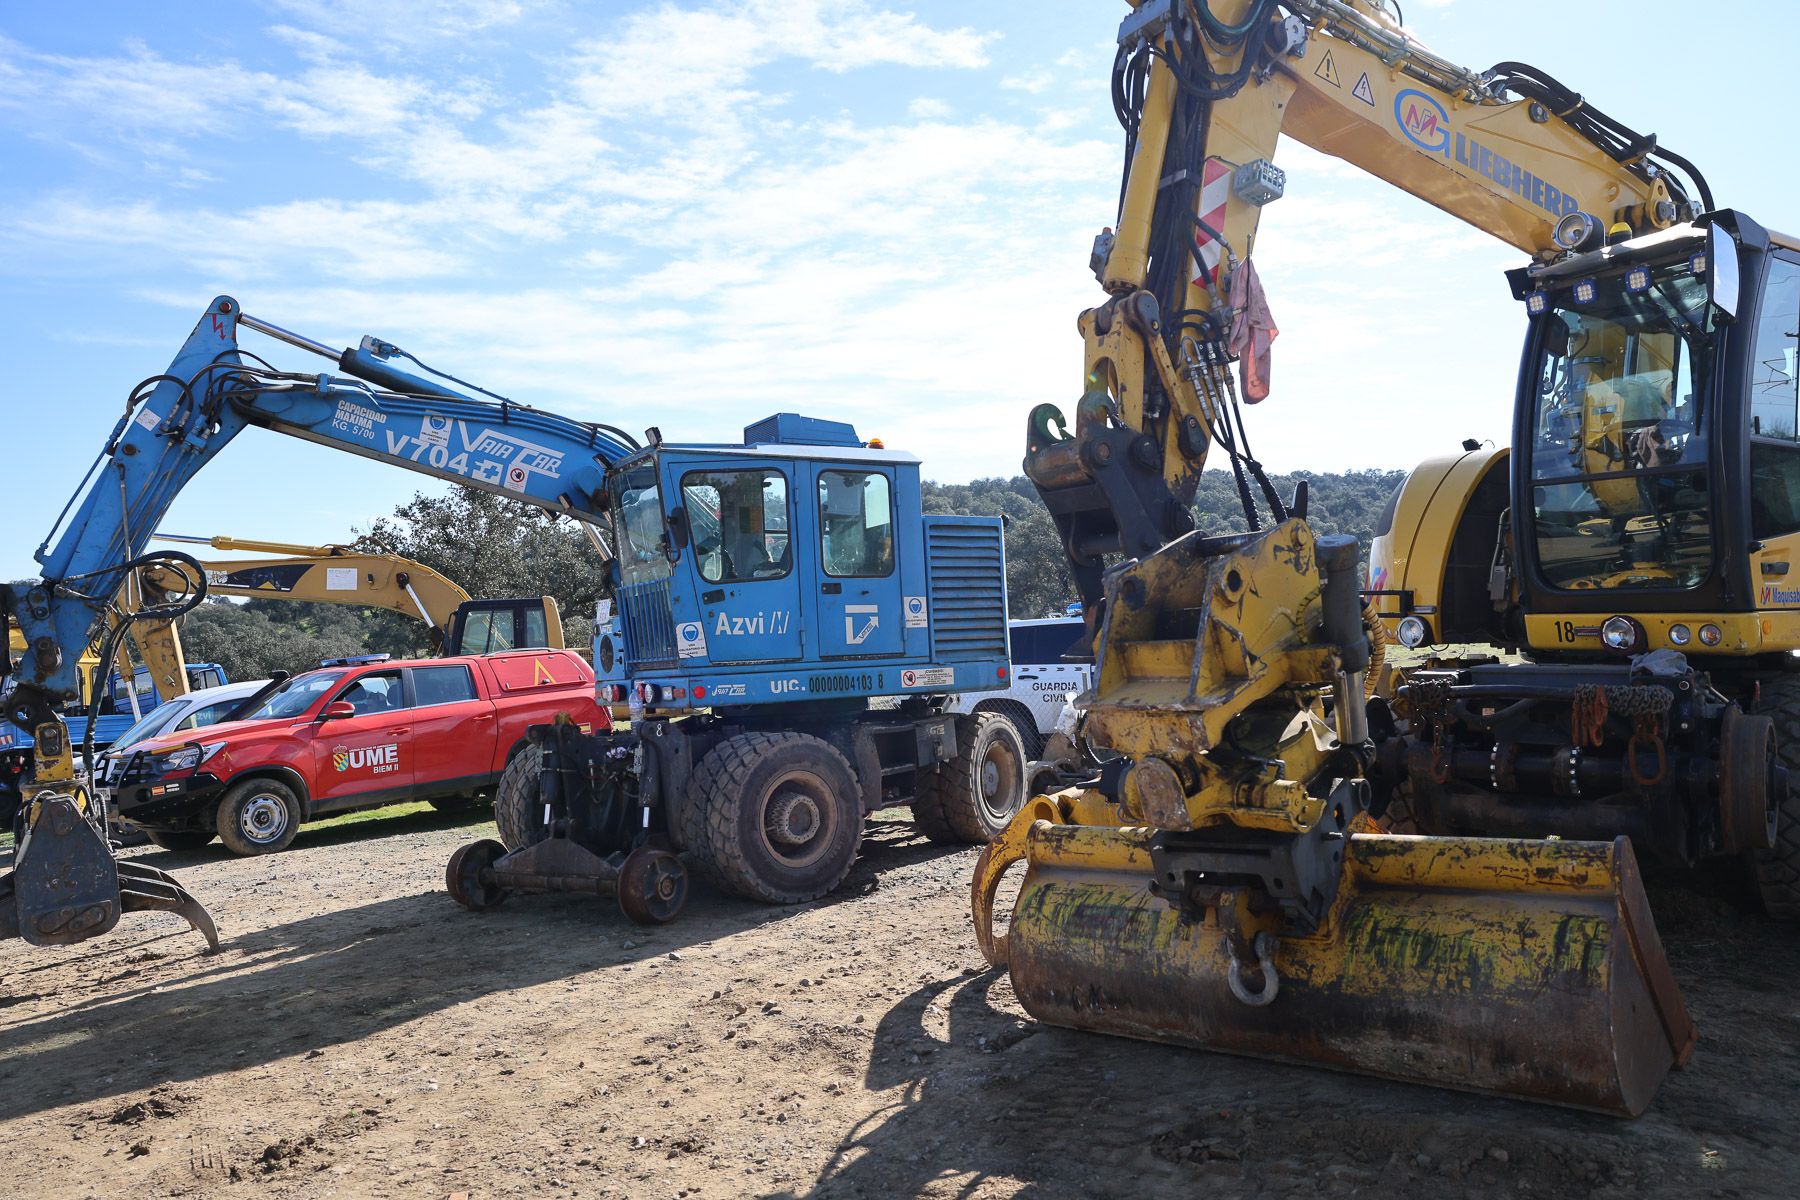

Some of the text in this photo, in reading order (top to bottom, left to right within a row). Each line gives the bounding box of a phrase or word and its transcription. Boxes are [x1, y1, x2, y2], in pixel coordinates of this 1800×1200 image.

[334, 409, 373, 430] MAXIMA
[337, 399, 388, 424] CAPACIDAD
[332, 418, 375, 440] KG. 5700
[715, 611, 764, 635] Azvi
[1554, 620, 1576, 643] 18
[809, 674, 873, 693] 00000004103
[877, 673, 884, 689] 8
[1032, 681, 1078, 691] GUARDIA
[1042, 693, 1068, 703] CIVIL
[349, 746, 399, 769] UME
[373, 764, 393, 774] BIEM
